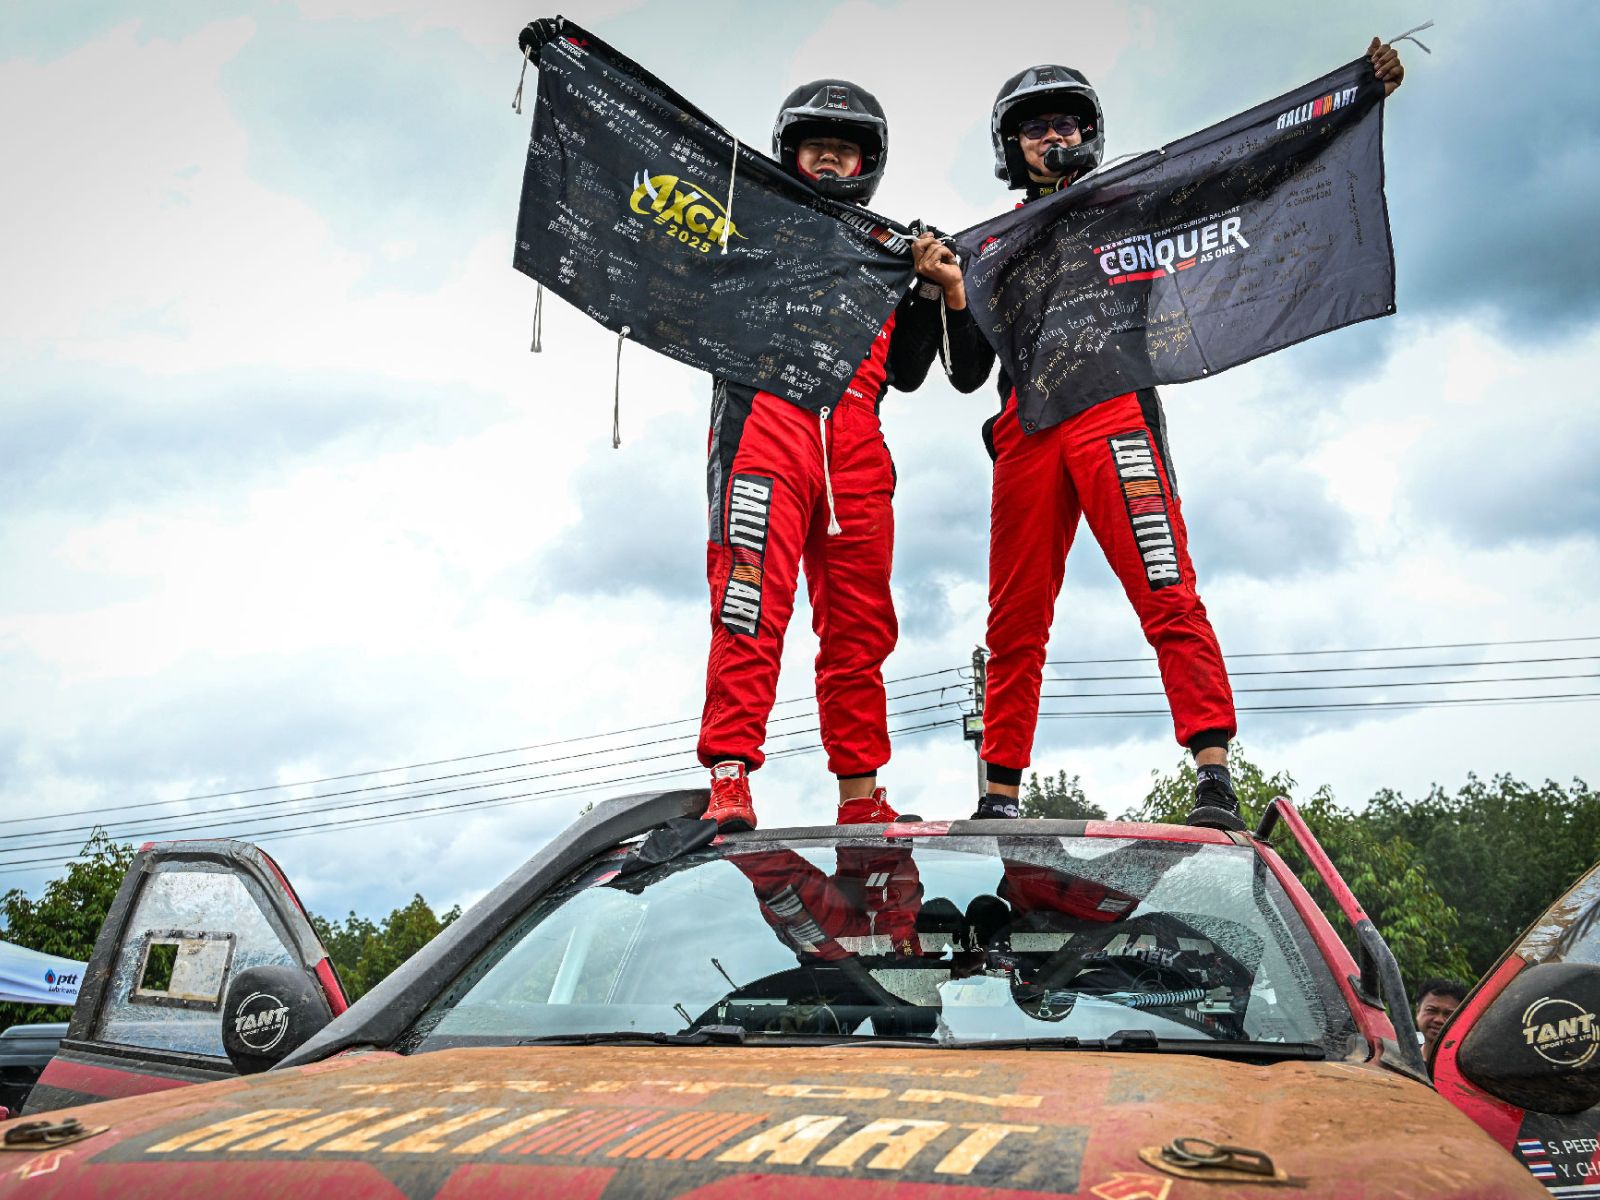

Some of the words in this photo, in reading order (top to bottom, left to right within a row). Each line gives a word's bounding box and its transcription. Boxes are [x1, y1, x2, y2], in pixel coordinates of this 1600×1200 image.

[666, 224, 712, 253] 2025
[1100, 217, 1250, 275] CONQUER
[1200, 253, 1213, 264] AS
[1215, 245, 1235, 259] ONE
[57, 974, 77, 985] ptt
[235, 1007, 290, 1033] TANT
[1522, 1013, 1596, 1045] TANT
[1540, 1040, 1564, 1051] SPORT
